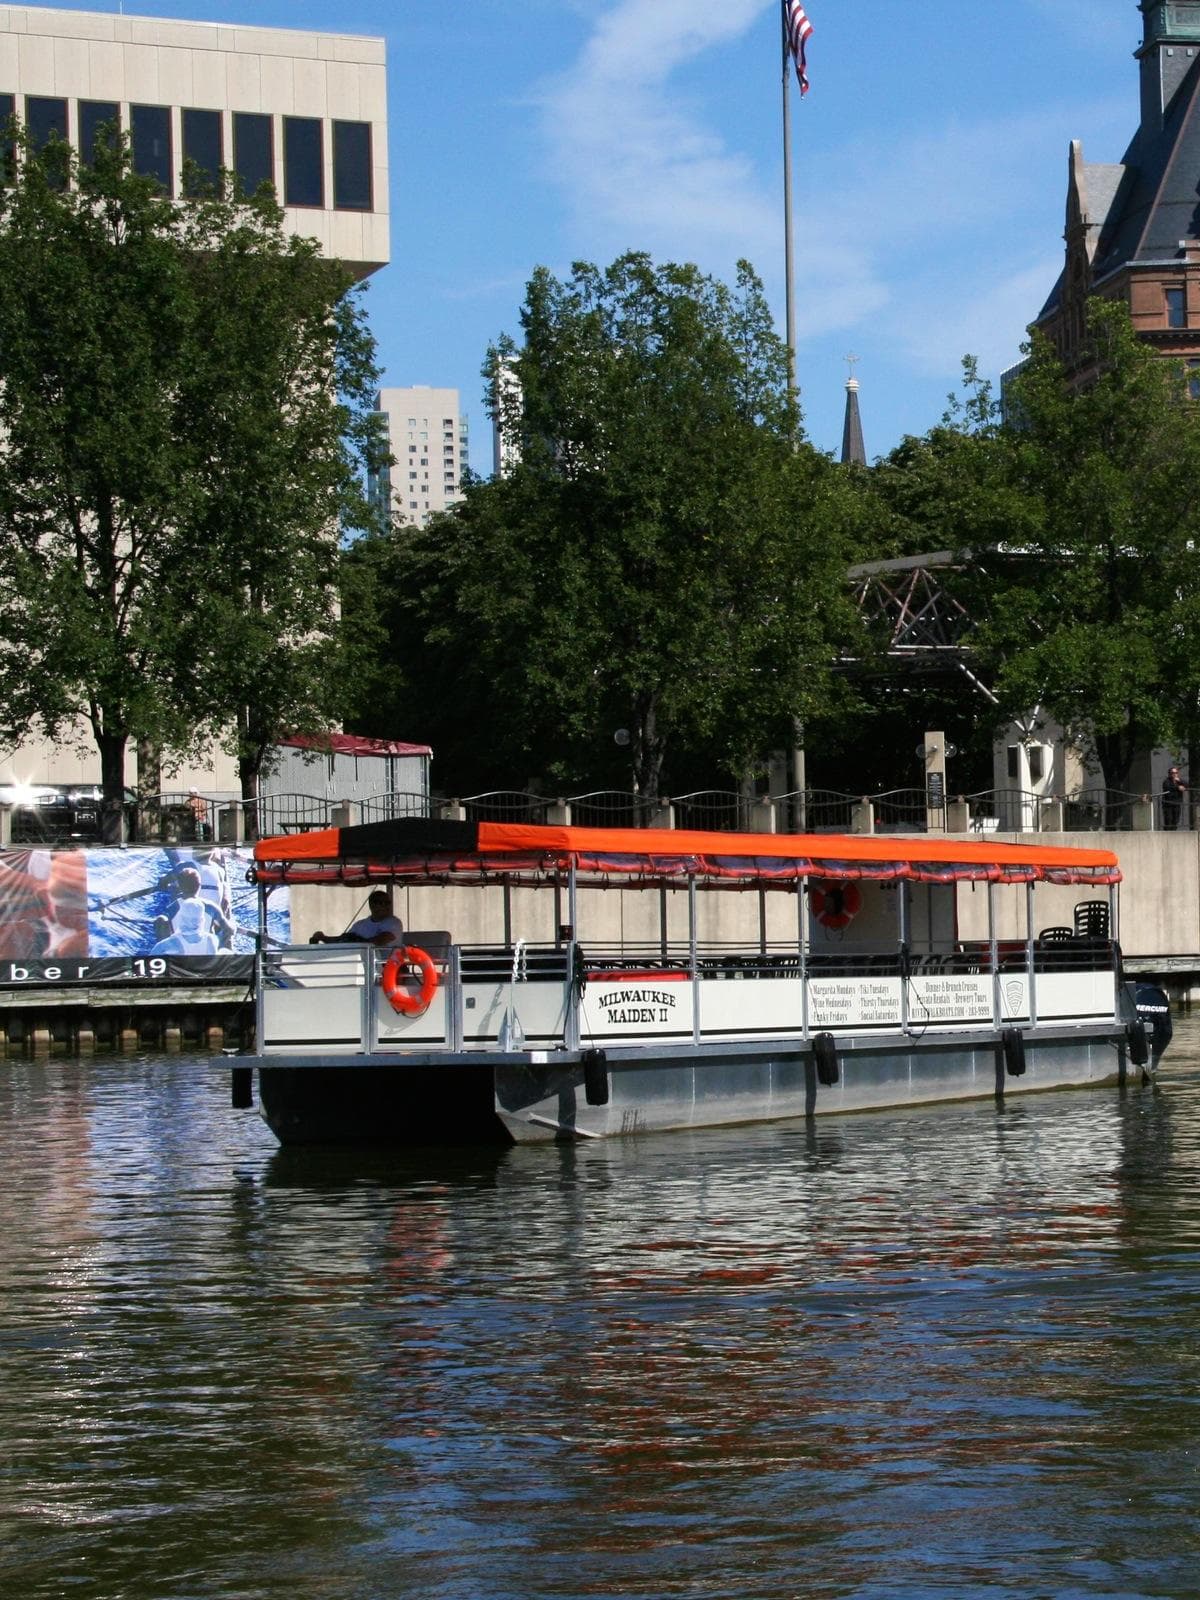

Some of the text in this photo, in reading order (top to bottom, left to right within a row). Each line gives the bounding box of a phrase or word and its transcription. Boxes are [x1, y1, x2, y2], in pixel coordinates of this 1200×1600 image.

[134, 958, 166, 976] 19
[870, 984, 889, 996] Tuesdays
[599, 990, 676, 1009] MILWAUKEE
[825, 998, 852, 1010] Wednesdays
[877, 997, 899, 1008] Thursdays
[608, 1008, 668, 1023] MAIDEN II
[830, 1011, 848, 1023] Fridays
[875, 1010, 898, 1022] Saturdays
